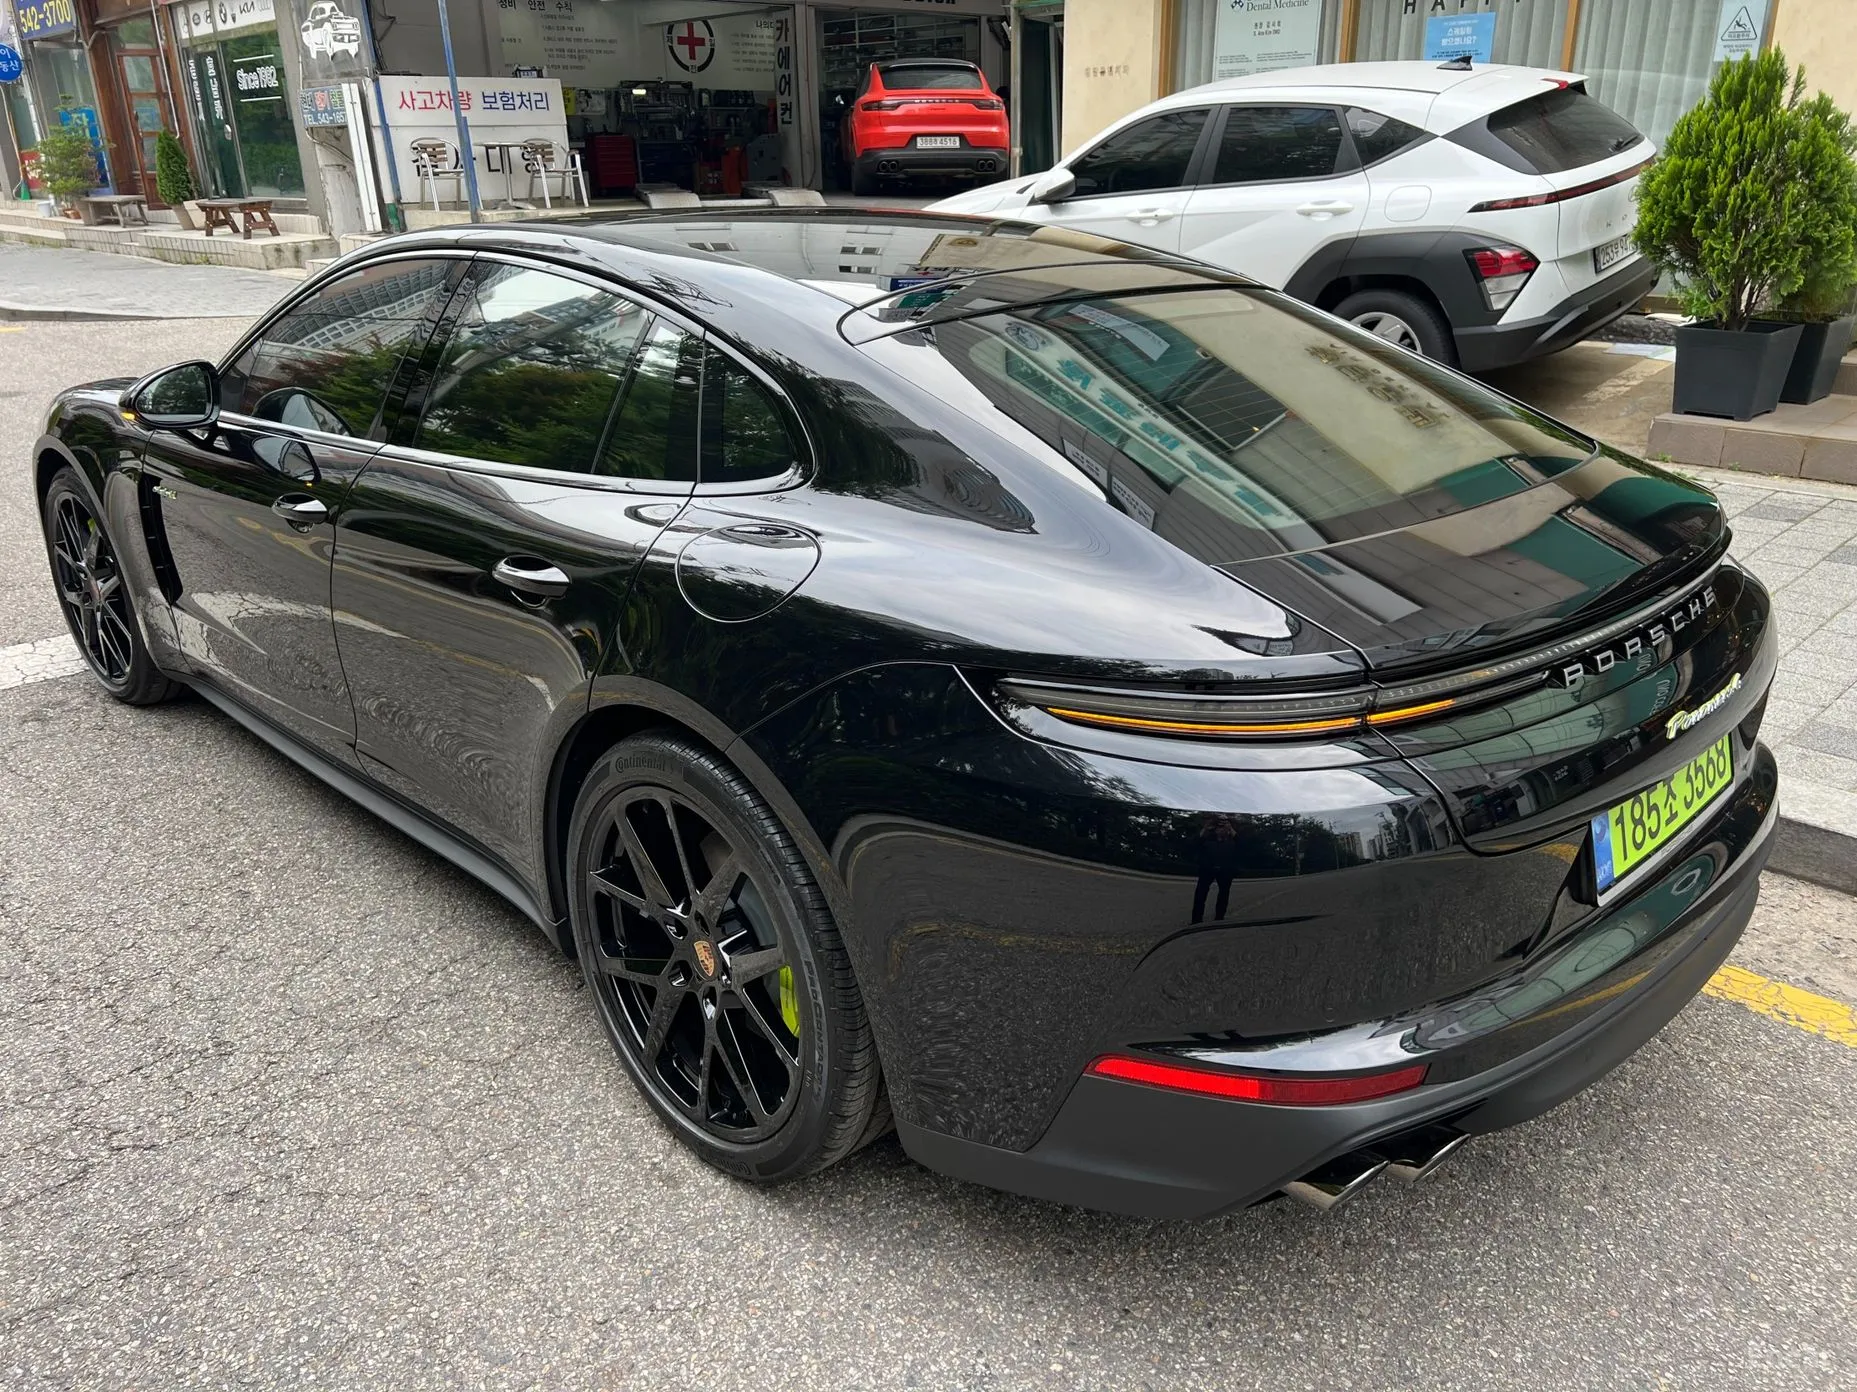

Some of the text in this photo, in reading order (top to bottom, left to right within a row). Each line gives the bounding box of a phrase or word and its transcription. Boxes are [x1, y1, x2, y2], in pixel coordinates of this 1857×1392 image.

[19, 0, 72, 33] 542-3700
[1246, 1, 1272, 12] Dental
[236, 67, 260, 91] Since
[399, 90, 472, 111] 사고차량
[481, 89, 551, 111] 보험처리
[1563, 585, 1716, 688] PORSCHE
[615, 754, 666, 774] Continental
[1684, 738, 1726, 811] 3568
